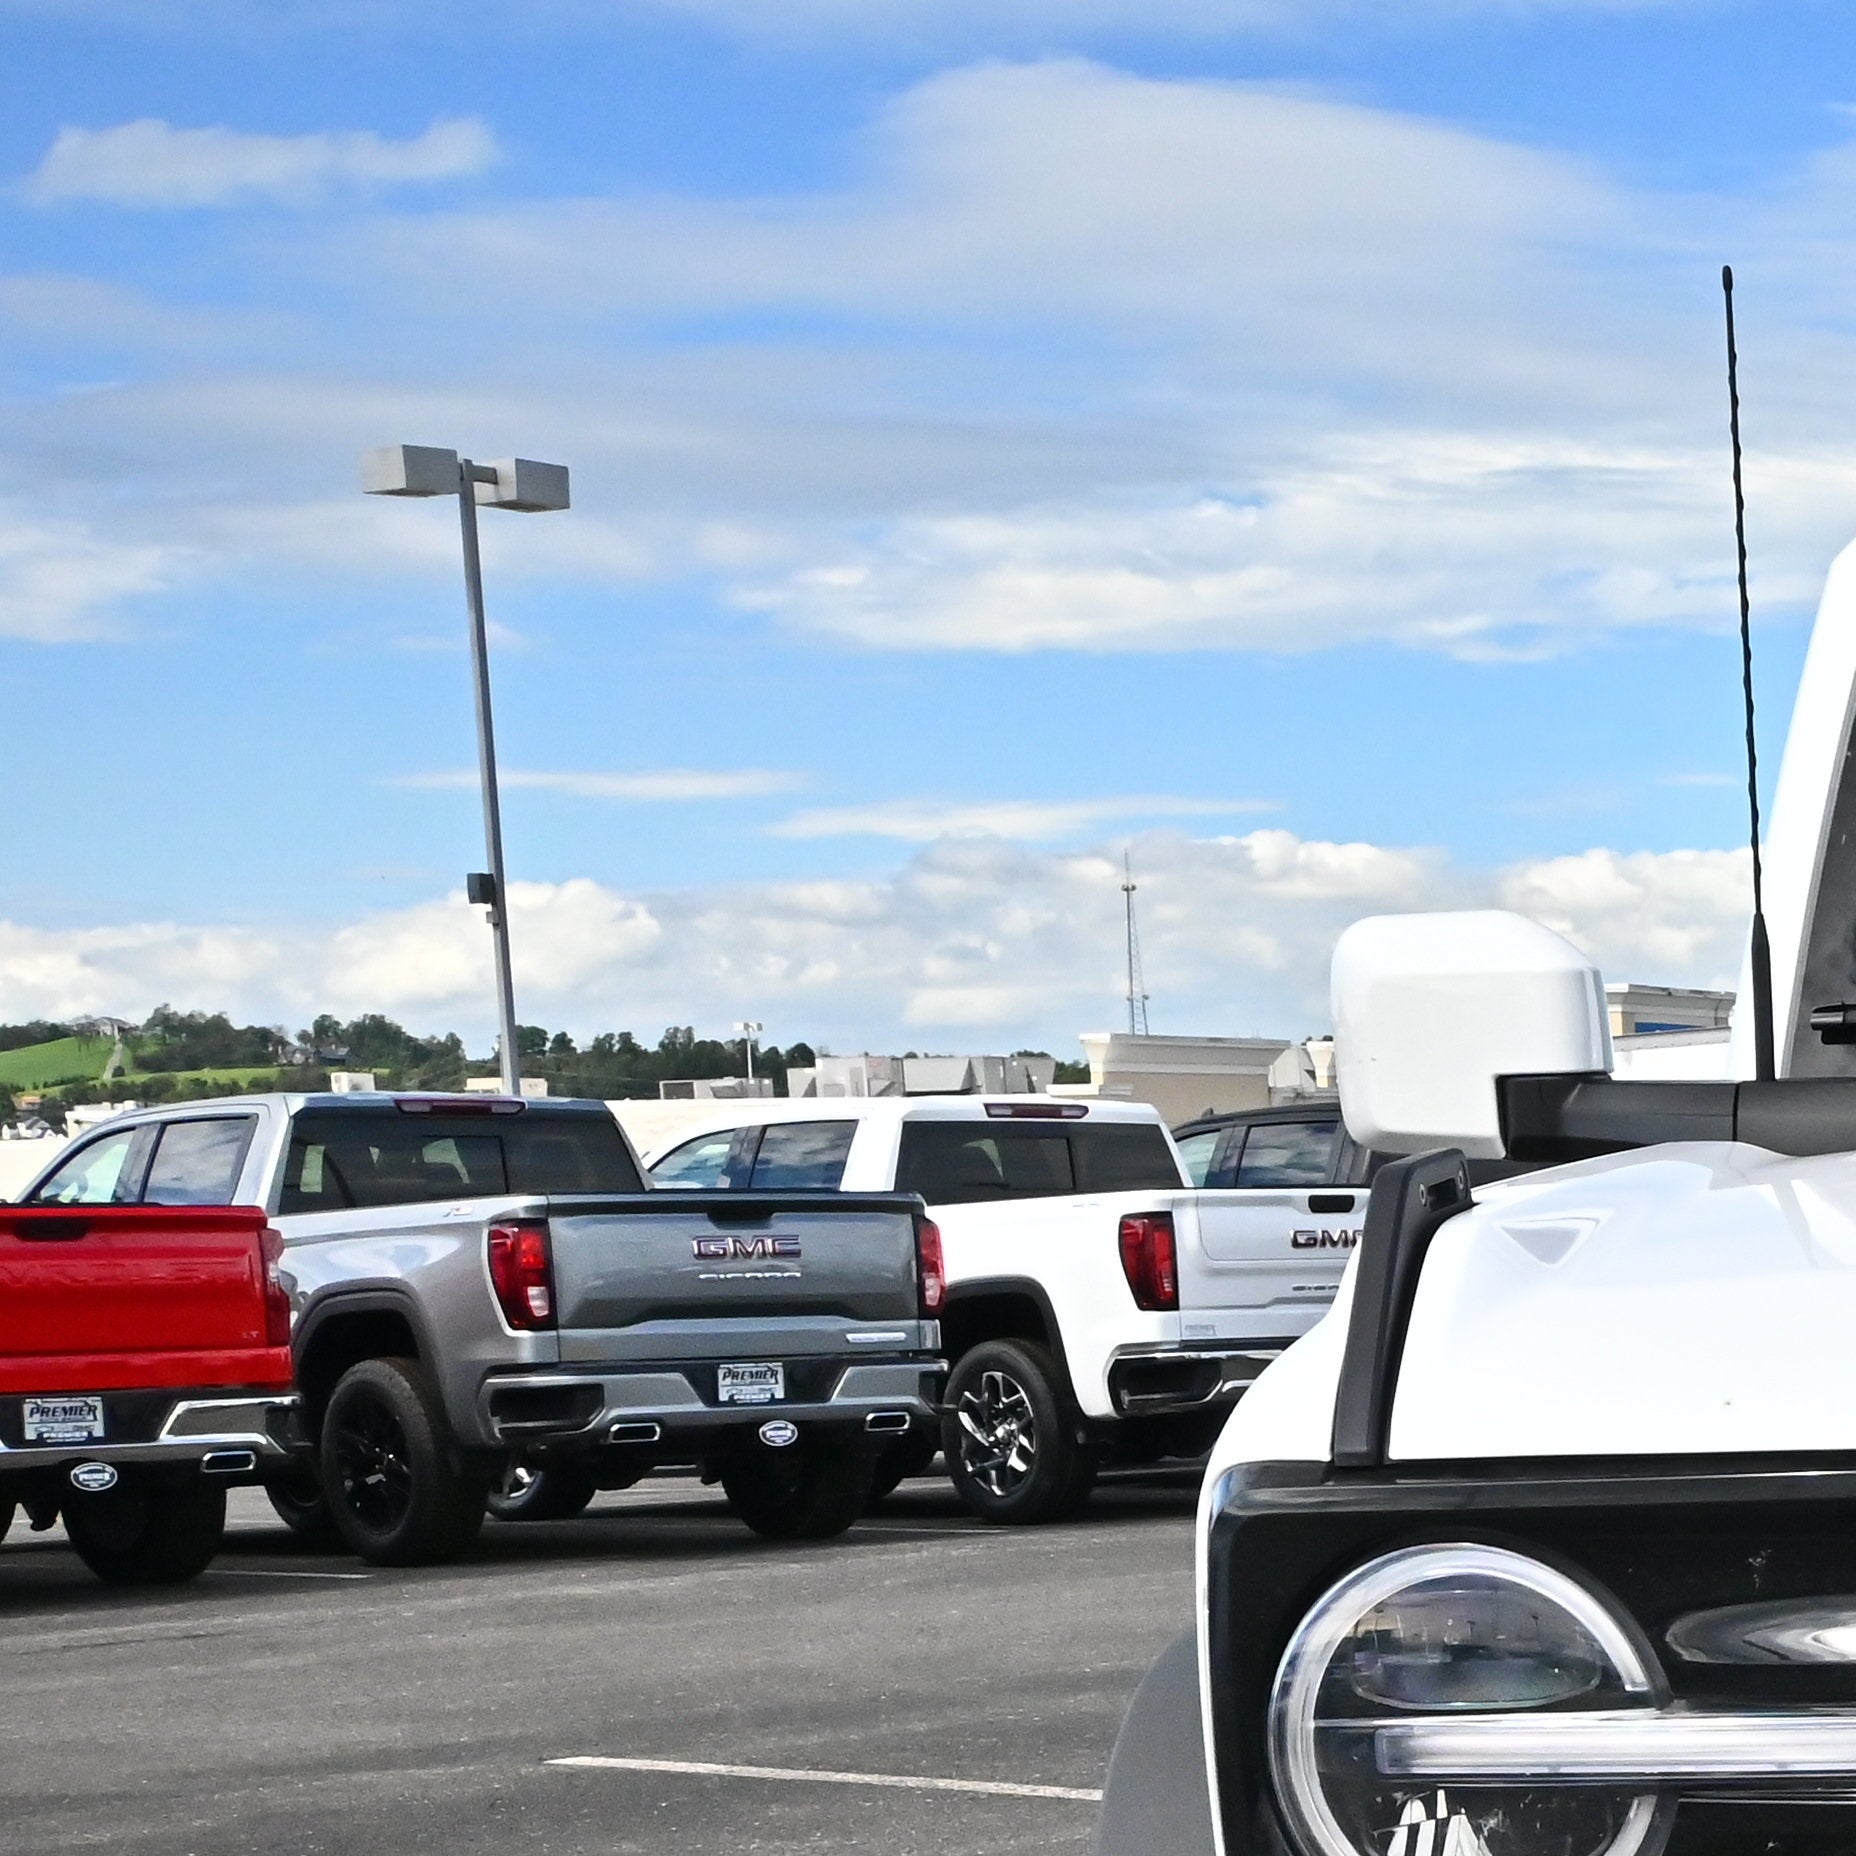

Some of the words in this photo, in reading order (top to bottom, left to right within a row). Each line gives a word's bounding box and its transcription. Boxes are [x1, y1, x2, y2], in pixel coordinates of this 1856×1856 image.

[692, 1234, 801, 1260] GMC
[723, 1369, 779, 1384] PREMIER
[29, 1405, 98, 1421] PREMIER
